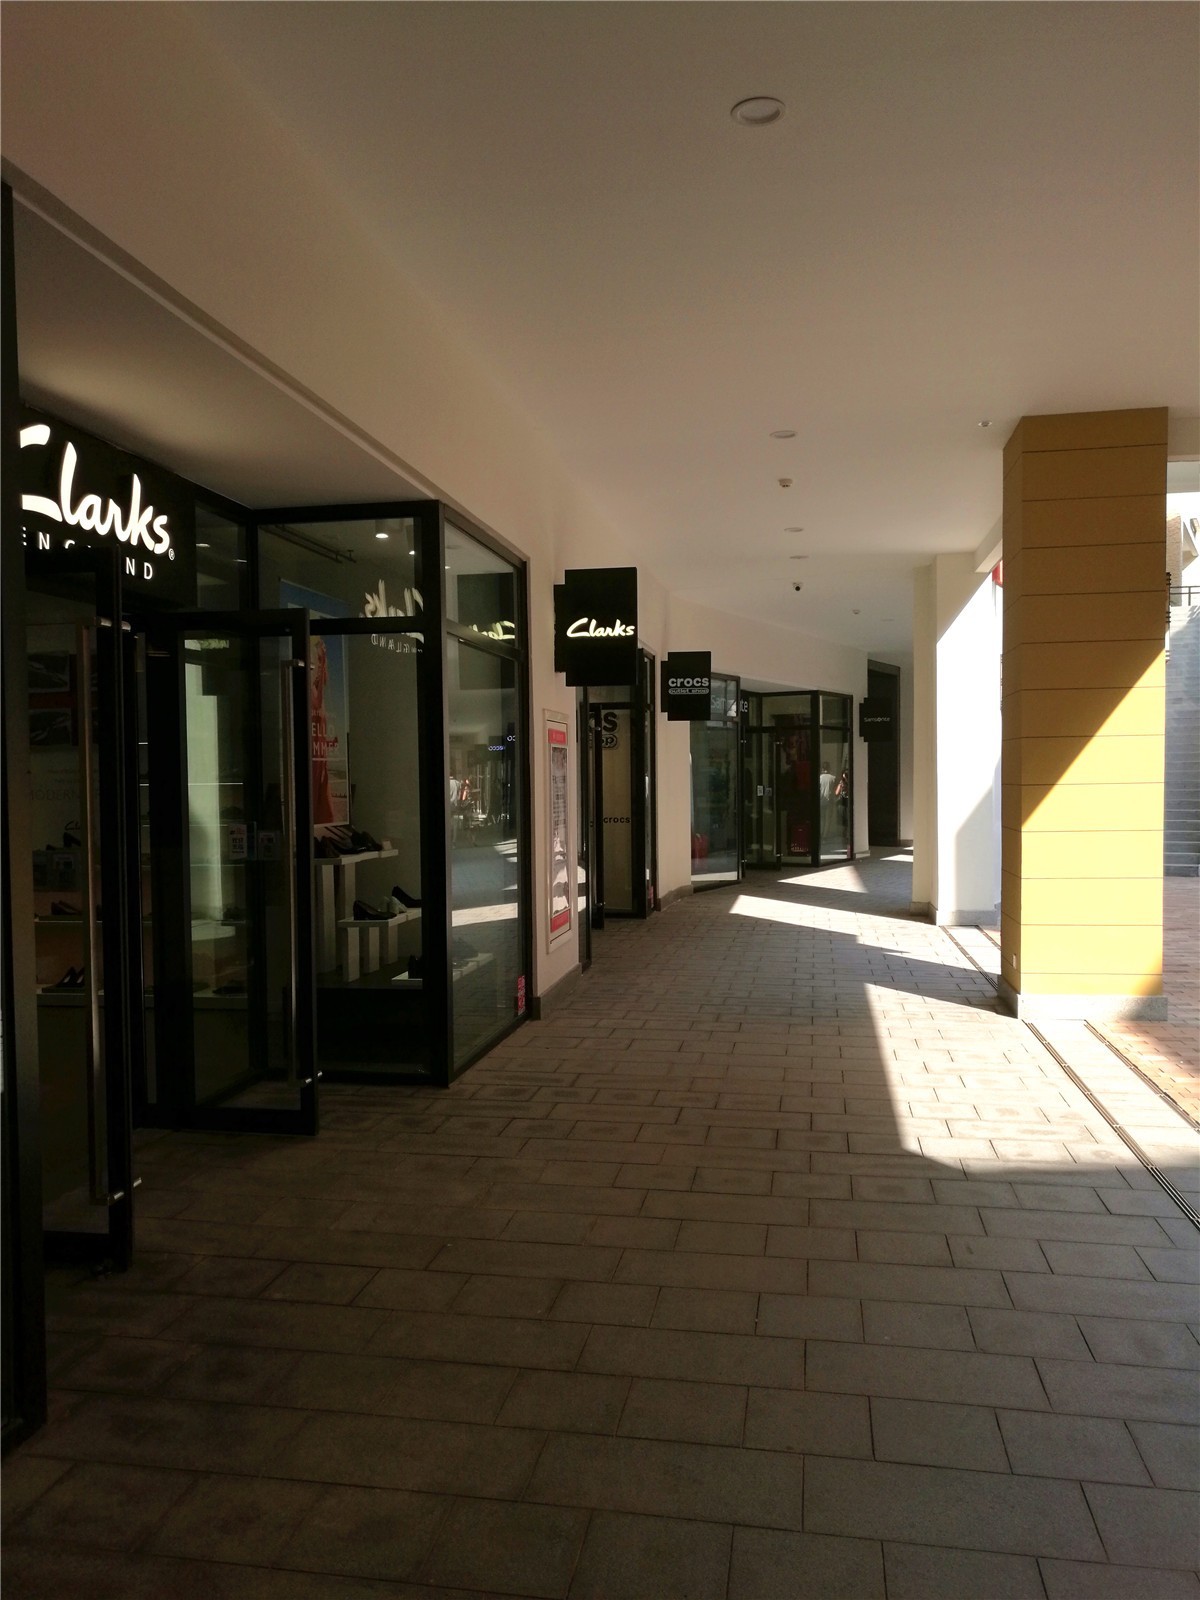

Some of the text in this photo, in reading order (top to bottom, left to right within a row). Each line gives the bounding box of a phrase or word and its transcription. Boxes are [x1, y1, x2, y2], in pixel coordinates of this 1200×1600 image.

[565, 616, 636, 638] Clarks
[668, 677, 710, 688] crocs
[603, 816, 631, 824] crocs
